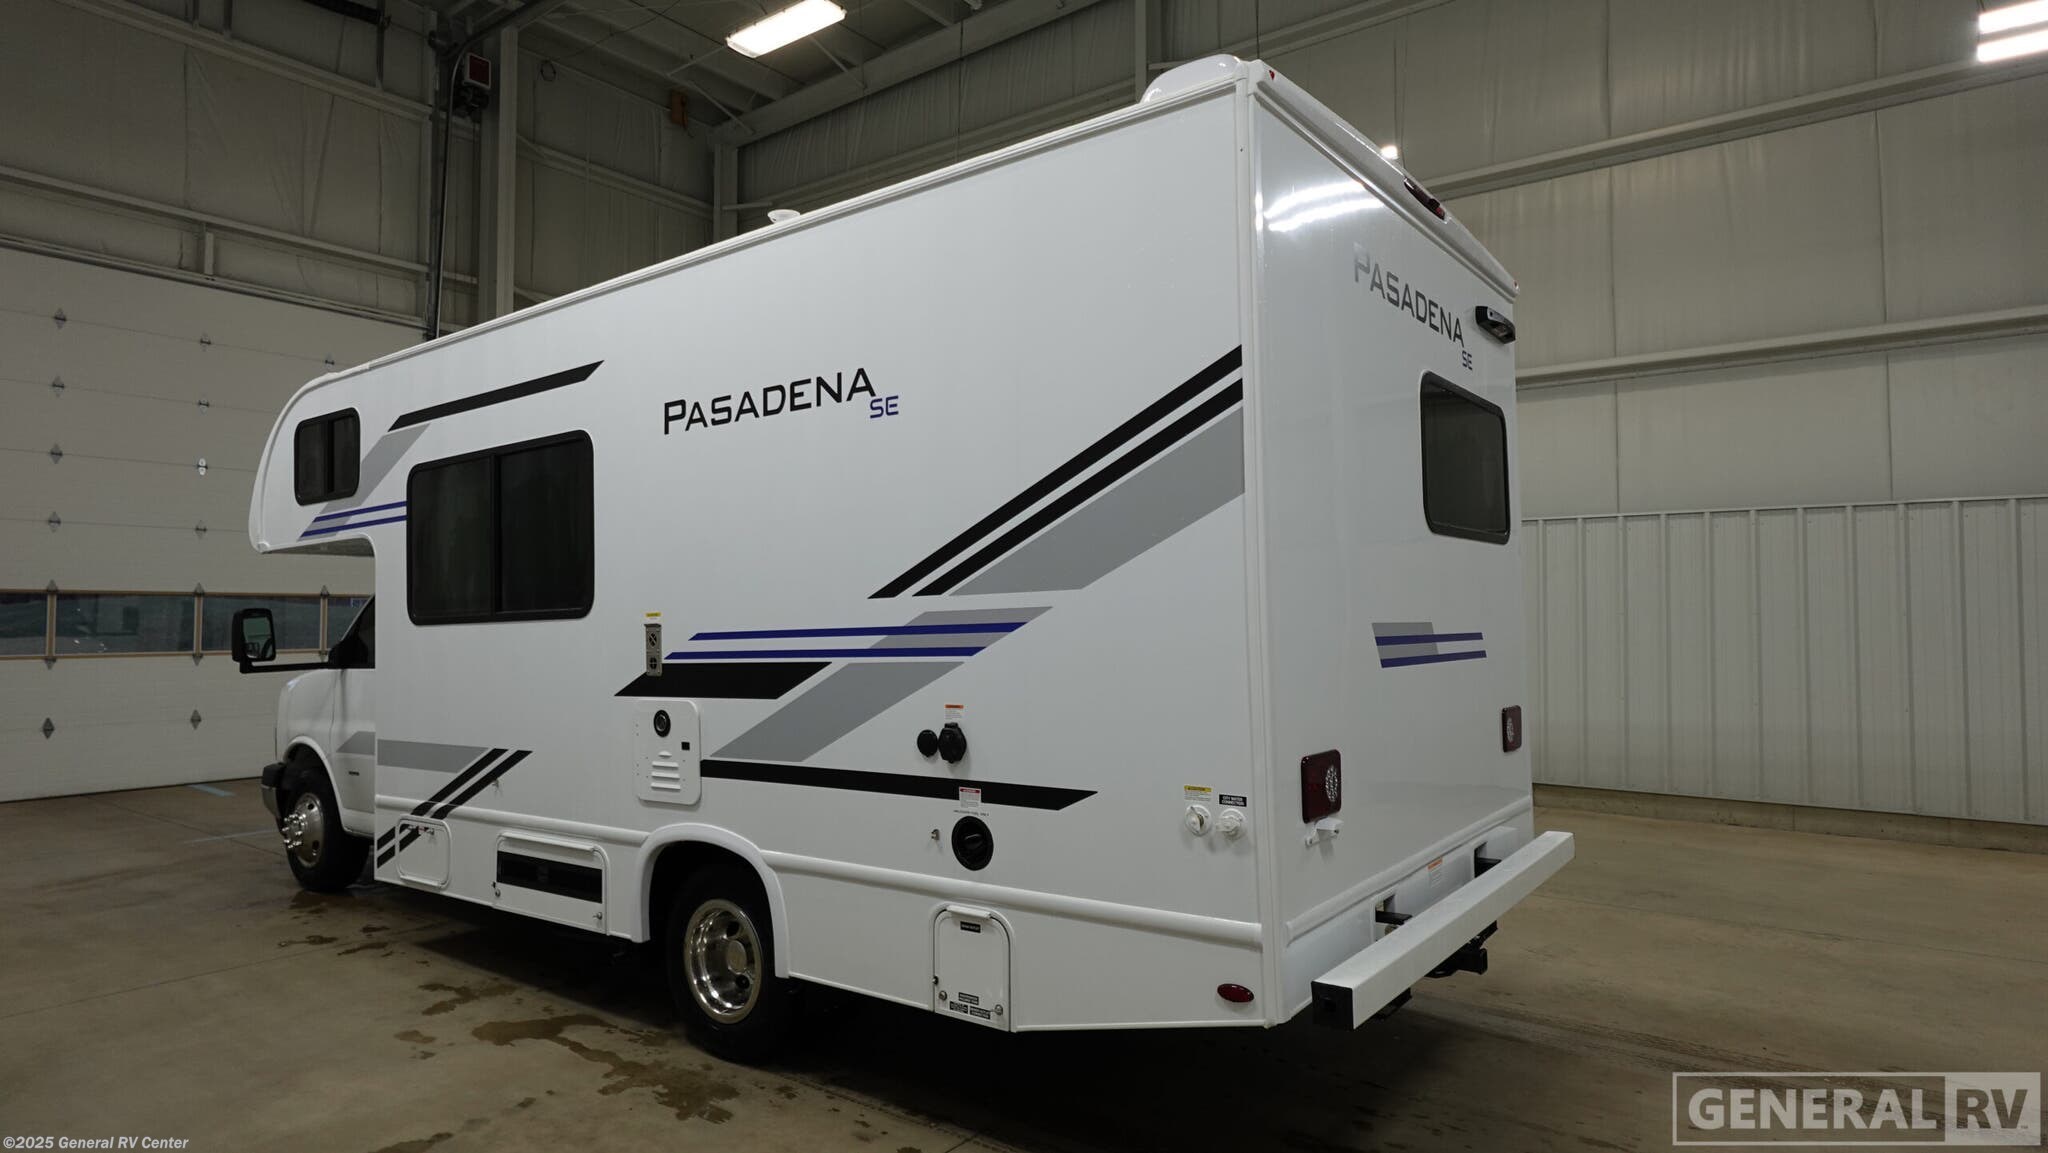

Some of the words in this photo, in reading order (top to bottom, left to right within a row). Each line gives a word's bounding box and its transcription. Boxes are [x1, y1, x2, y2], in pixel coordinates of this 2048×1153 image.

[1353, 241, 1465, 348] PASADENA
[1461, 349, 1473, 371] SE
[664, 367, 876, 435] PASADENA
[870, 395, 899, 419] SE
